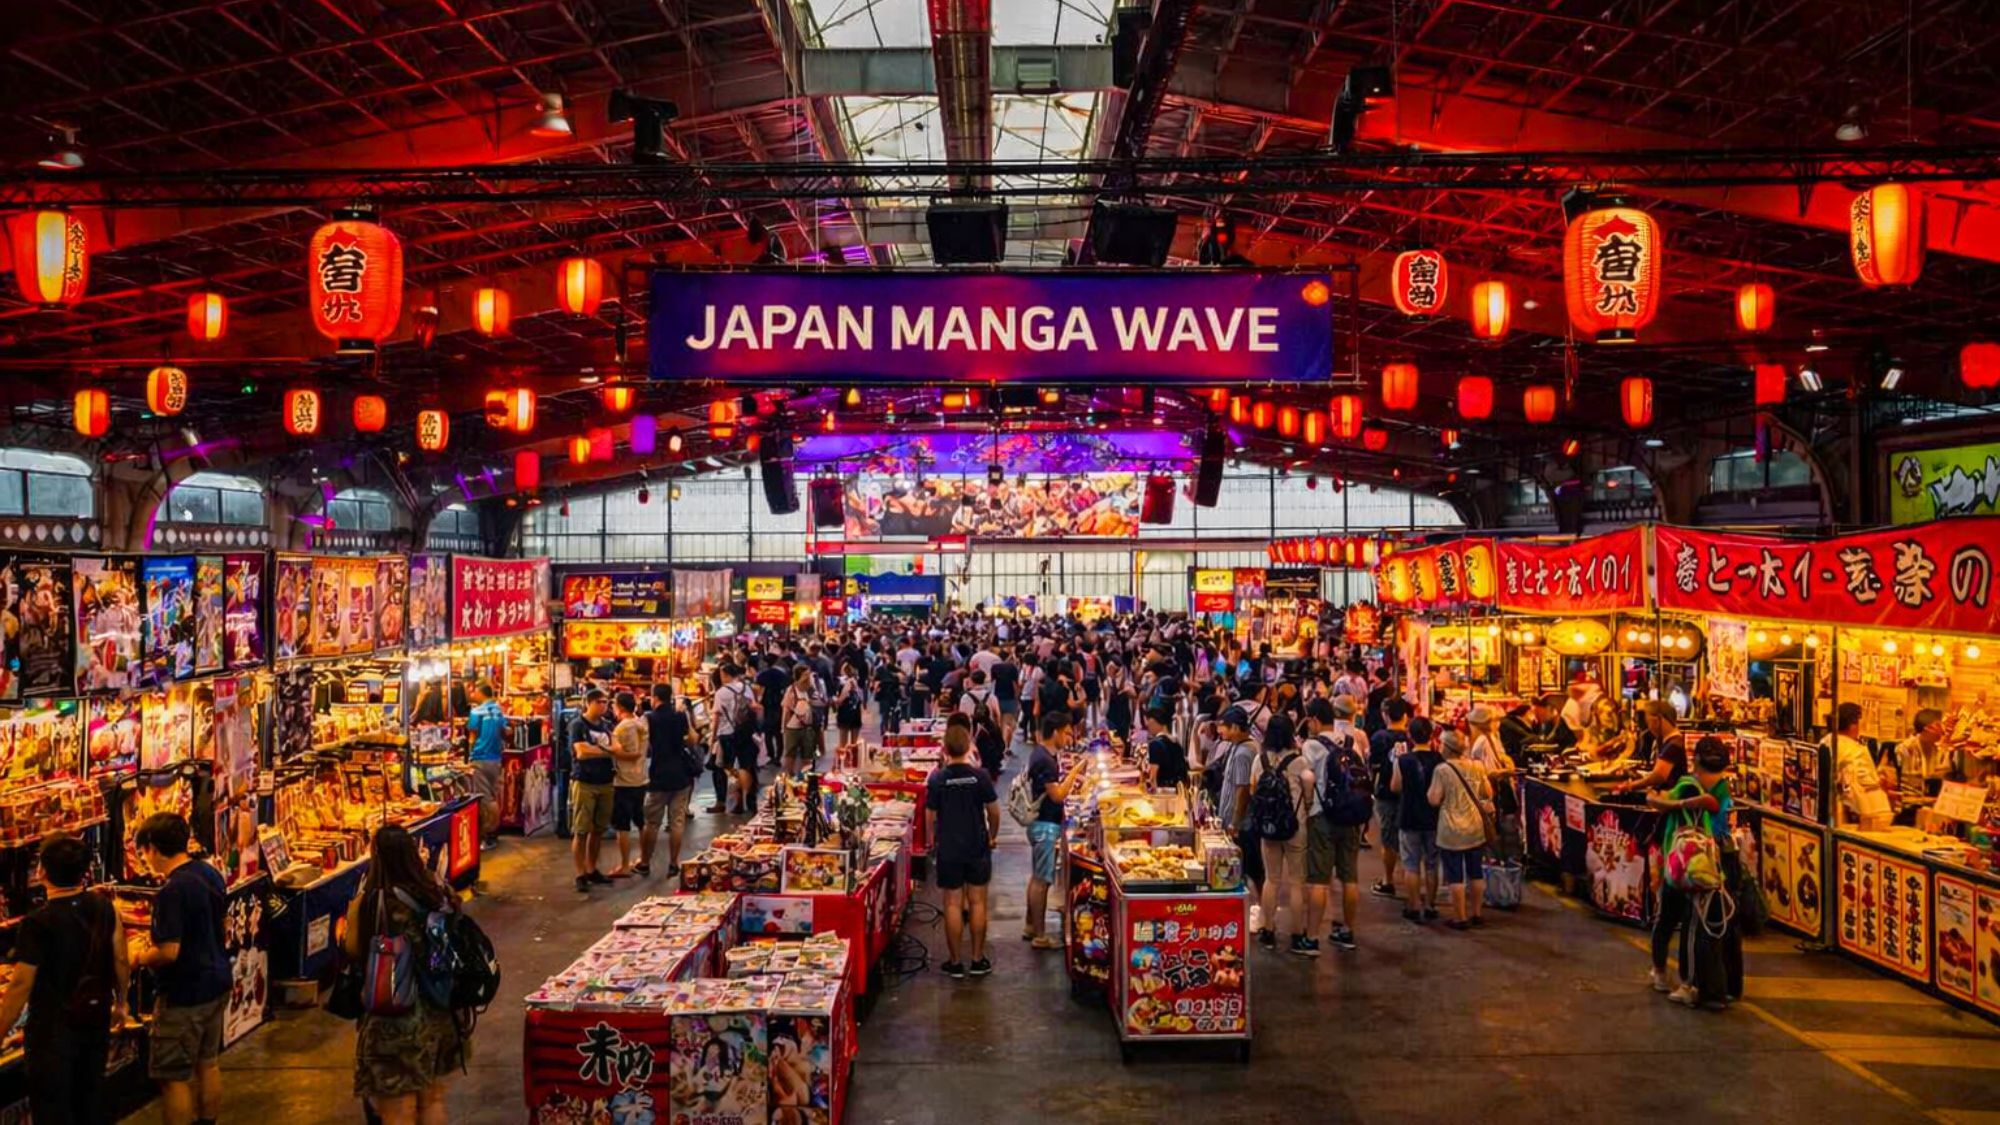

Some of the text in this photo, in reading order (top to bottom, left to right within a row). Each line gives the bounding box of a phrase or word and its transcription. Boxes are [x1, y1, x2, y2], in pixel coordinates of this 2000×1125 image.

[686, 304, 1280, 352] JAPAN MANGA WAVE
